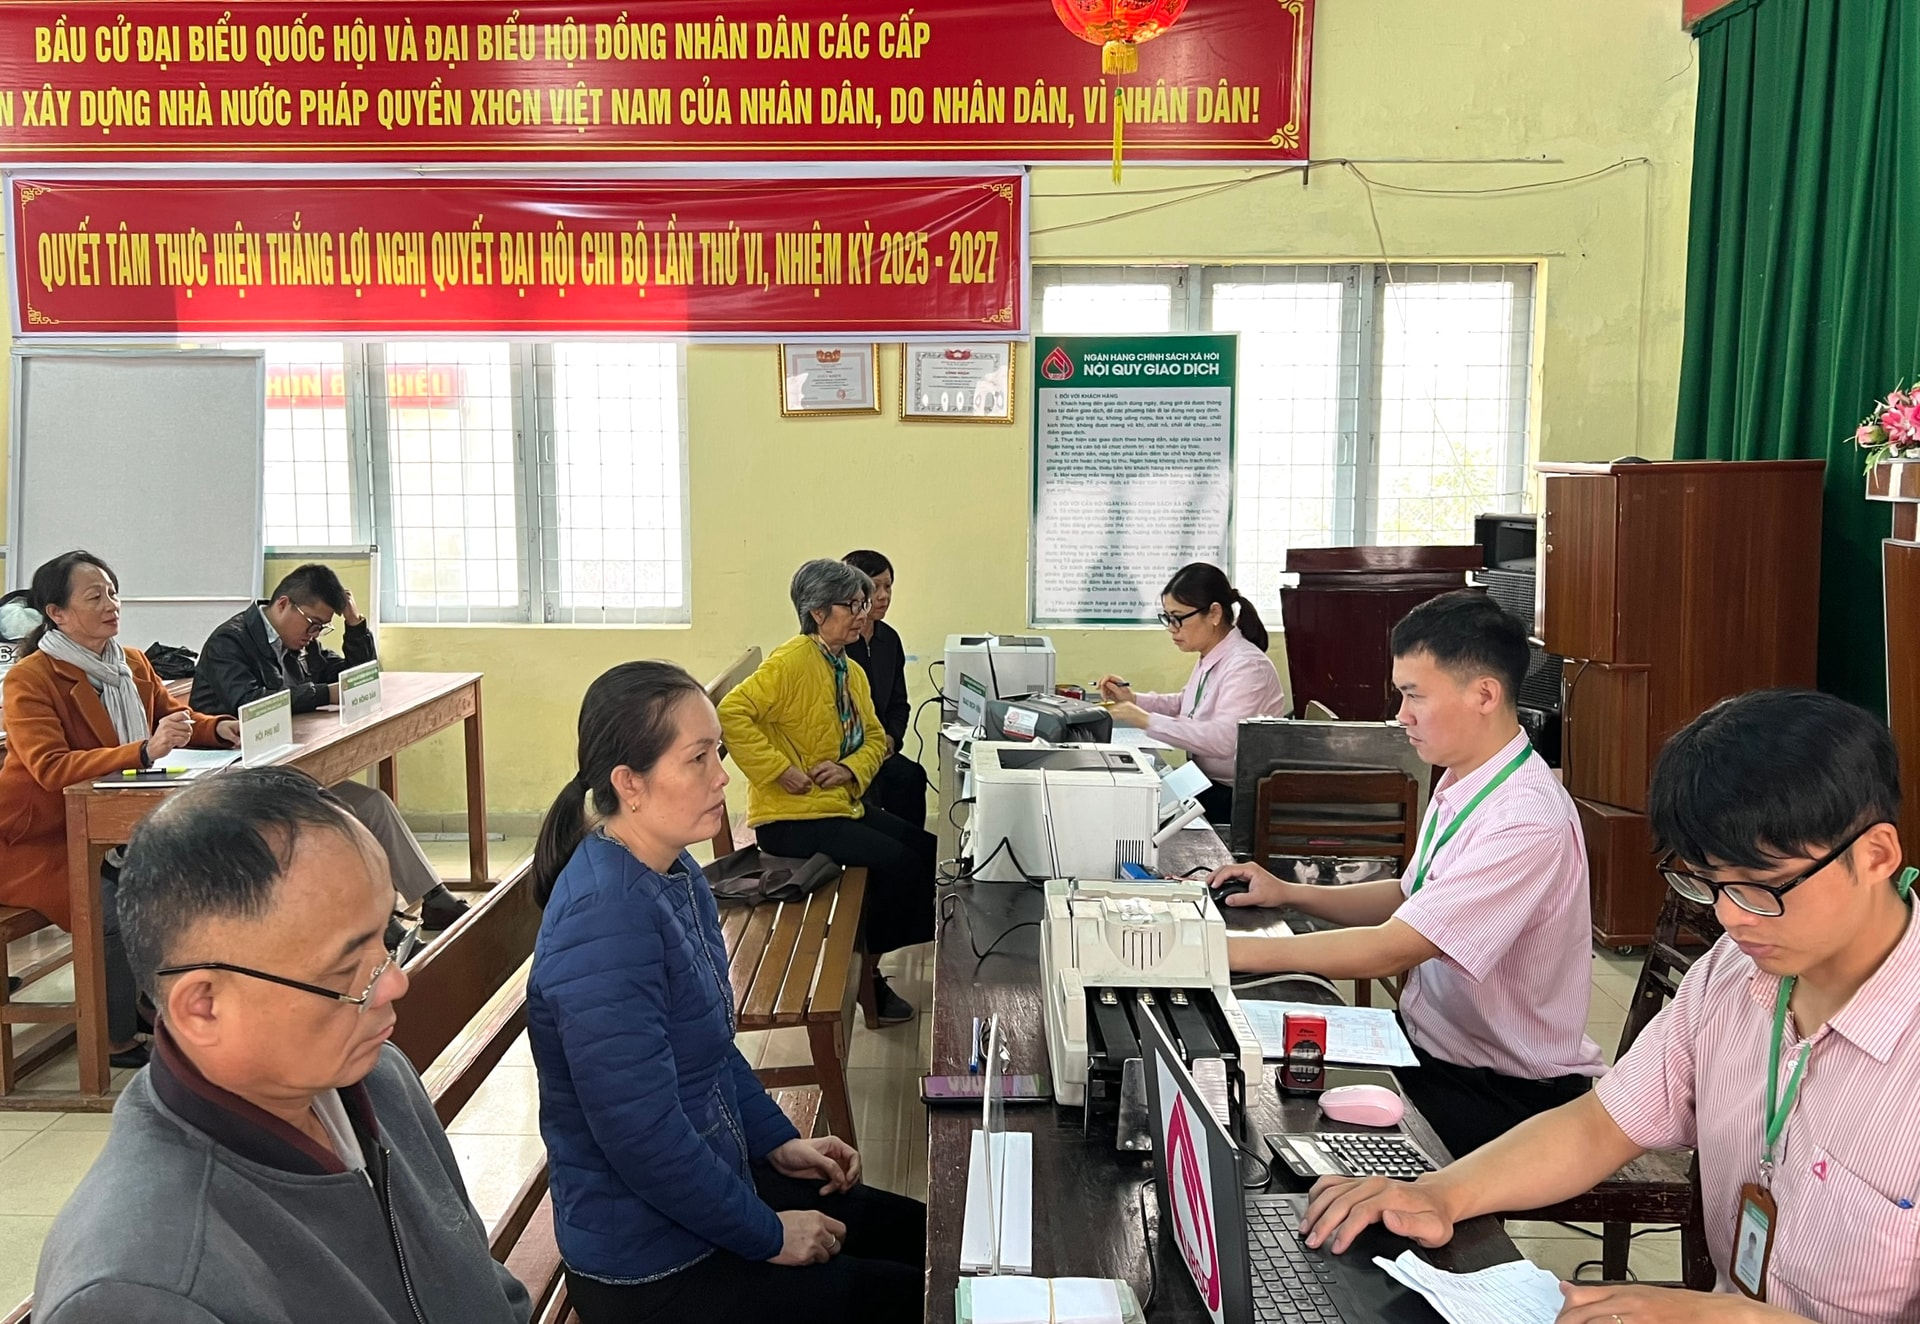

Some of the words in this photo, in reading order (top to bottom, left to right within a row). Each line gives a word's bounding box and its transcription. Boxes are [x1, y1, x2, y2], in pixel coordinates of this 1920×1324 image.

[36, 15, 86, 63] BẦU
[95, 14, 131, 62] CỬ
[137, 26, 180, 70] ĐẠI
[189, 11, 247, 62] BIỂU
[256, 13, 324, 66] QUỐC
[334, 18, 376, 69] HỘI
[384, 18, 417, 61] VÀ
[425, 25, 468, 69] ĐẠI
[478, 9, 537, 62] BIỂU
[543, 17, 588, 69] HỘI
[595, 11, 666, 60] ĐỒNG
[675, 16, 747, 59] NHÂN
[757, 15, 809, 59] DÂN
[819, 14, 869, 59] CÁC
[879, 9, 930, 58] CẤP
[22, 83, 71, 127] XÂY
[80, 87, 150, 134] DỰNG
[159, 82, 213, 125] NHÀ
[221, 82, 291, 126] NƯỚC
[300, 82, 368, 125] PHÁP
[378, 77, 461, 130] QUYỀN
[471, 87, 543, 125] XHCN
[548, 80, 603, 134] VIỆT
[611, 89, 671, 124] NAM
[680, 76, 732, 125] CỦA
[741, 80, 812, 124] NHÂN
[822, 80, 881, 128] DÂN,
[891, 87, 924, 124] DO
[934, 79, 1004, 123] NHÂN
[1014, 79, 1074, 128] DÂN,
[1084, 78, 1108, 124] VÌ
[1119, 79, 1187, 123] NHÂN
[1195, 78, 1259, 123] DÂN!
[39, 216, 100, 292] QUYẾT
[106, 222, 151, 285] TÂM
[155, 227, 208, 298] THỰC
[214, 221, 262, 298] HIỆN
[266, 212, 334, 285] THẮNG
[339, 227, 371, 297] LỢI
[376, 232, 426, 297] NGHỊ
[432, 214, 493, 291] QUYẾT
[500, 232, 534, 297] ĐẠI
[541, 221, 574, 297] HỘI
[581, 232, 615, 285] CHI
[621, 221, 648, 297] BỘ
[654, 214, 693, 285] LẦN
[699, 221, 739, 285] THỨ
[744, 233, 768, 291] VI,
[776, 221, 841, 297] NHIỆM
[849, 221, 873, 284] KỲ
[880, 232, 928, 284] 2025
[935, 256, 942, 266] -
[950, 231, 998, 284] 2027
[268, 374, 320, 404] HỌN
[1083, 362, 1109, 377] NỘI
[1112, 364, 1144, 376] QUY
[1144, 364, 1182, 375] GIAO
[1184, 363, 1219, 376] DỊCH
